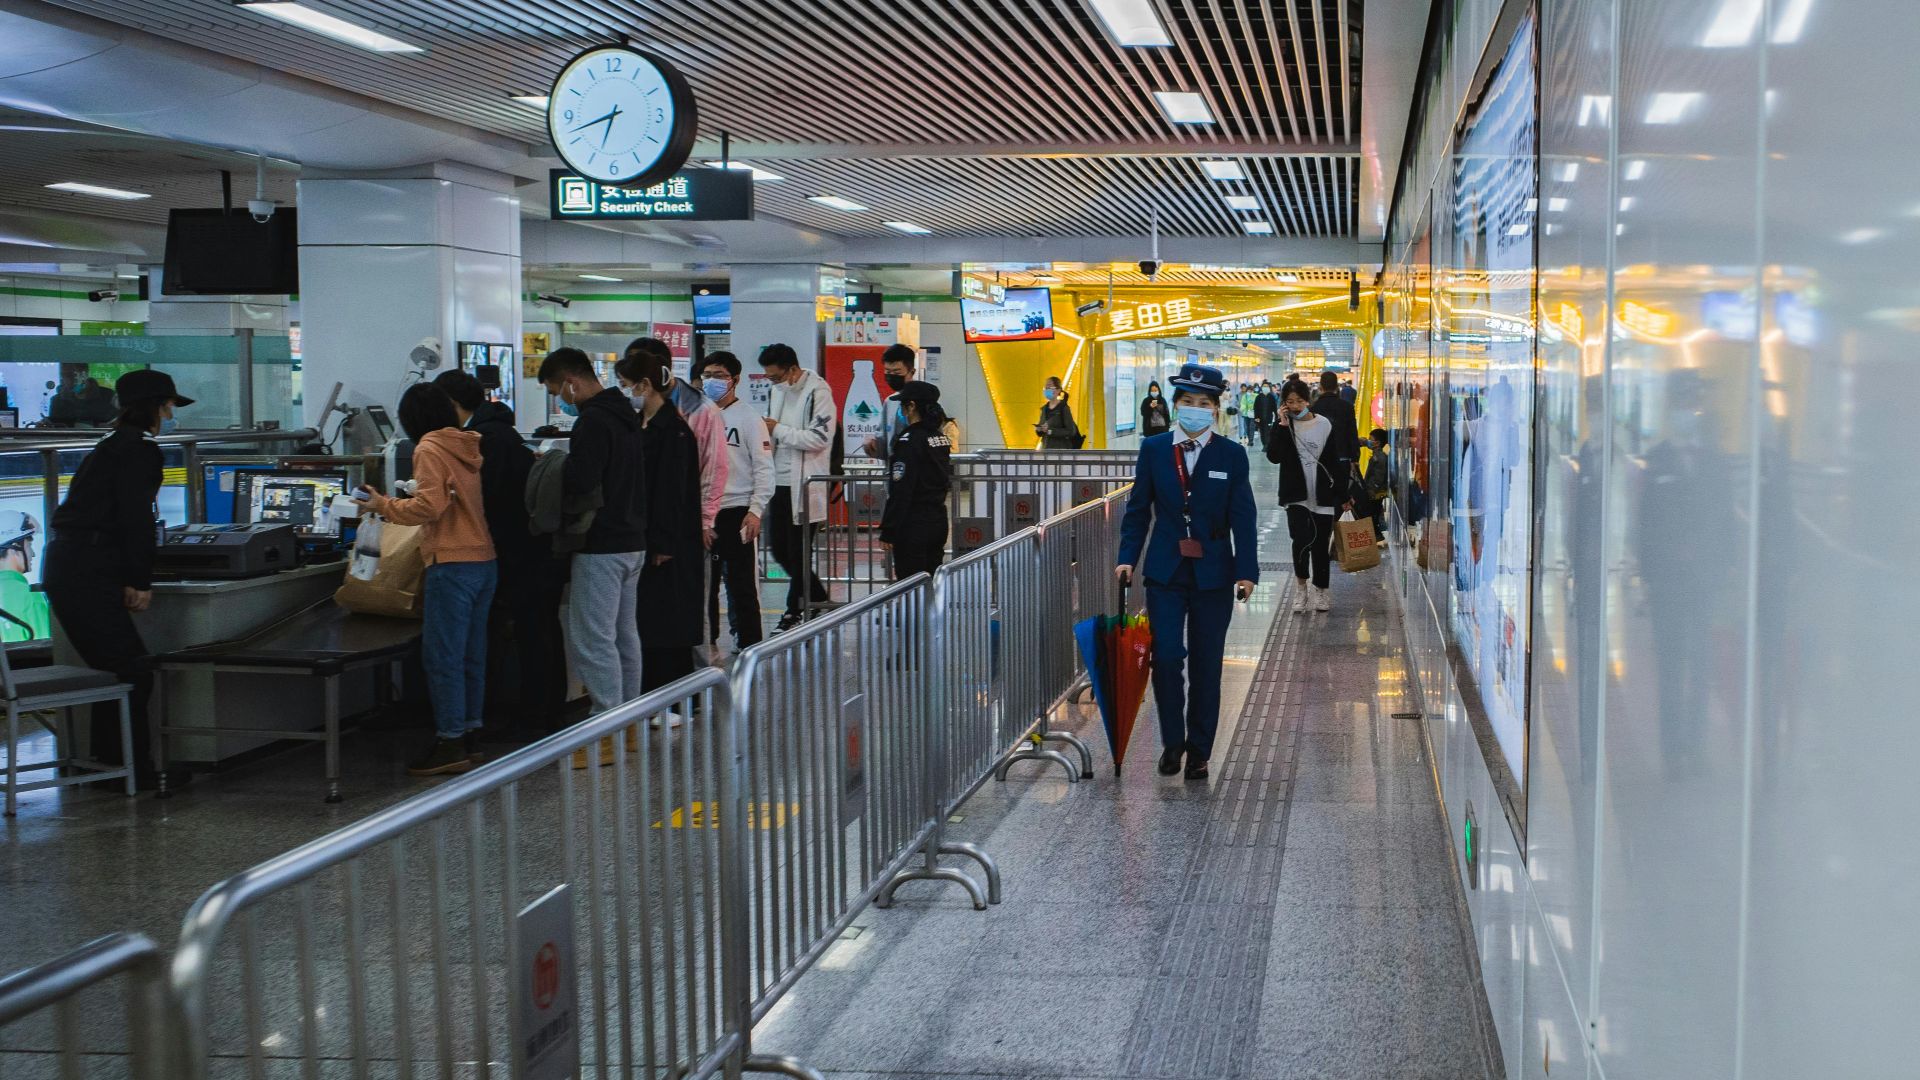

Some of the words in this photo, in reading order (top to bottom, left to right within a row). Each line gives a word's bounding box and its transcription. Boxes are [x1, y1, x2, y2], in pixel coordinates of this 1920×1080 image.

[605, 57, 622, 73] 12
[563, 109, 574, 123] 9
[655, 107, 664, 124] 3
[609, 160, 619, 175] 6
[600, 202, 652, 214] Security
[654, 201, 694, 213] Check
[1109, 298, 1192, 333] 麦田里
[1188, 314, 1270, 336] 地铁商业街
